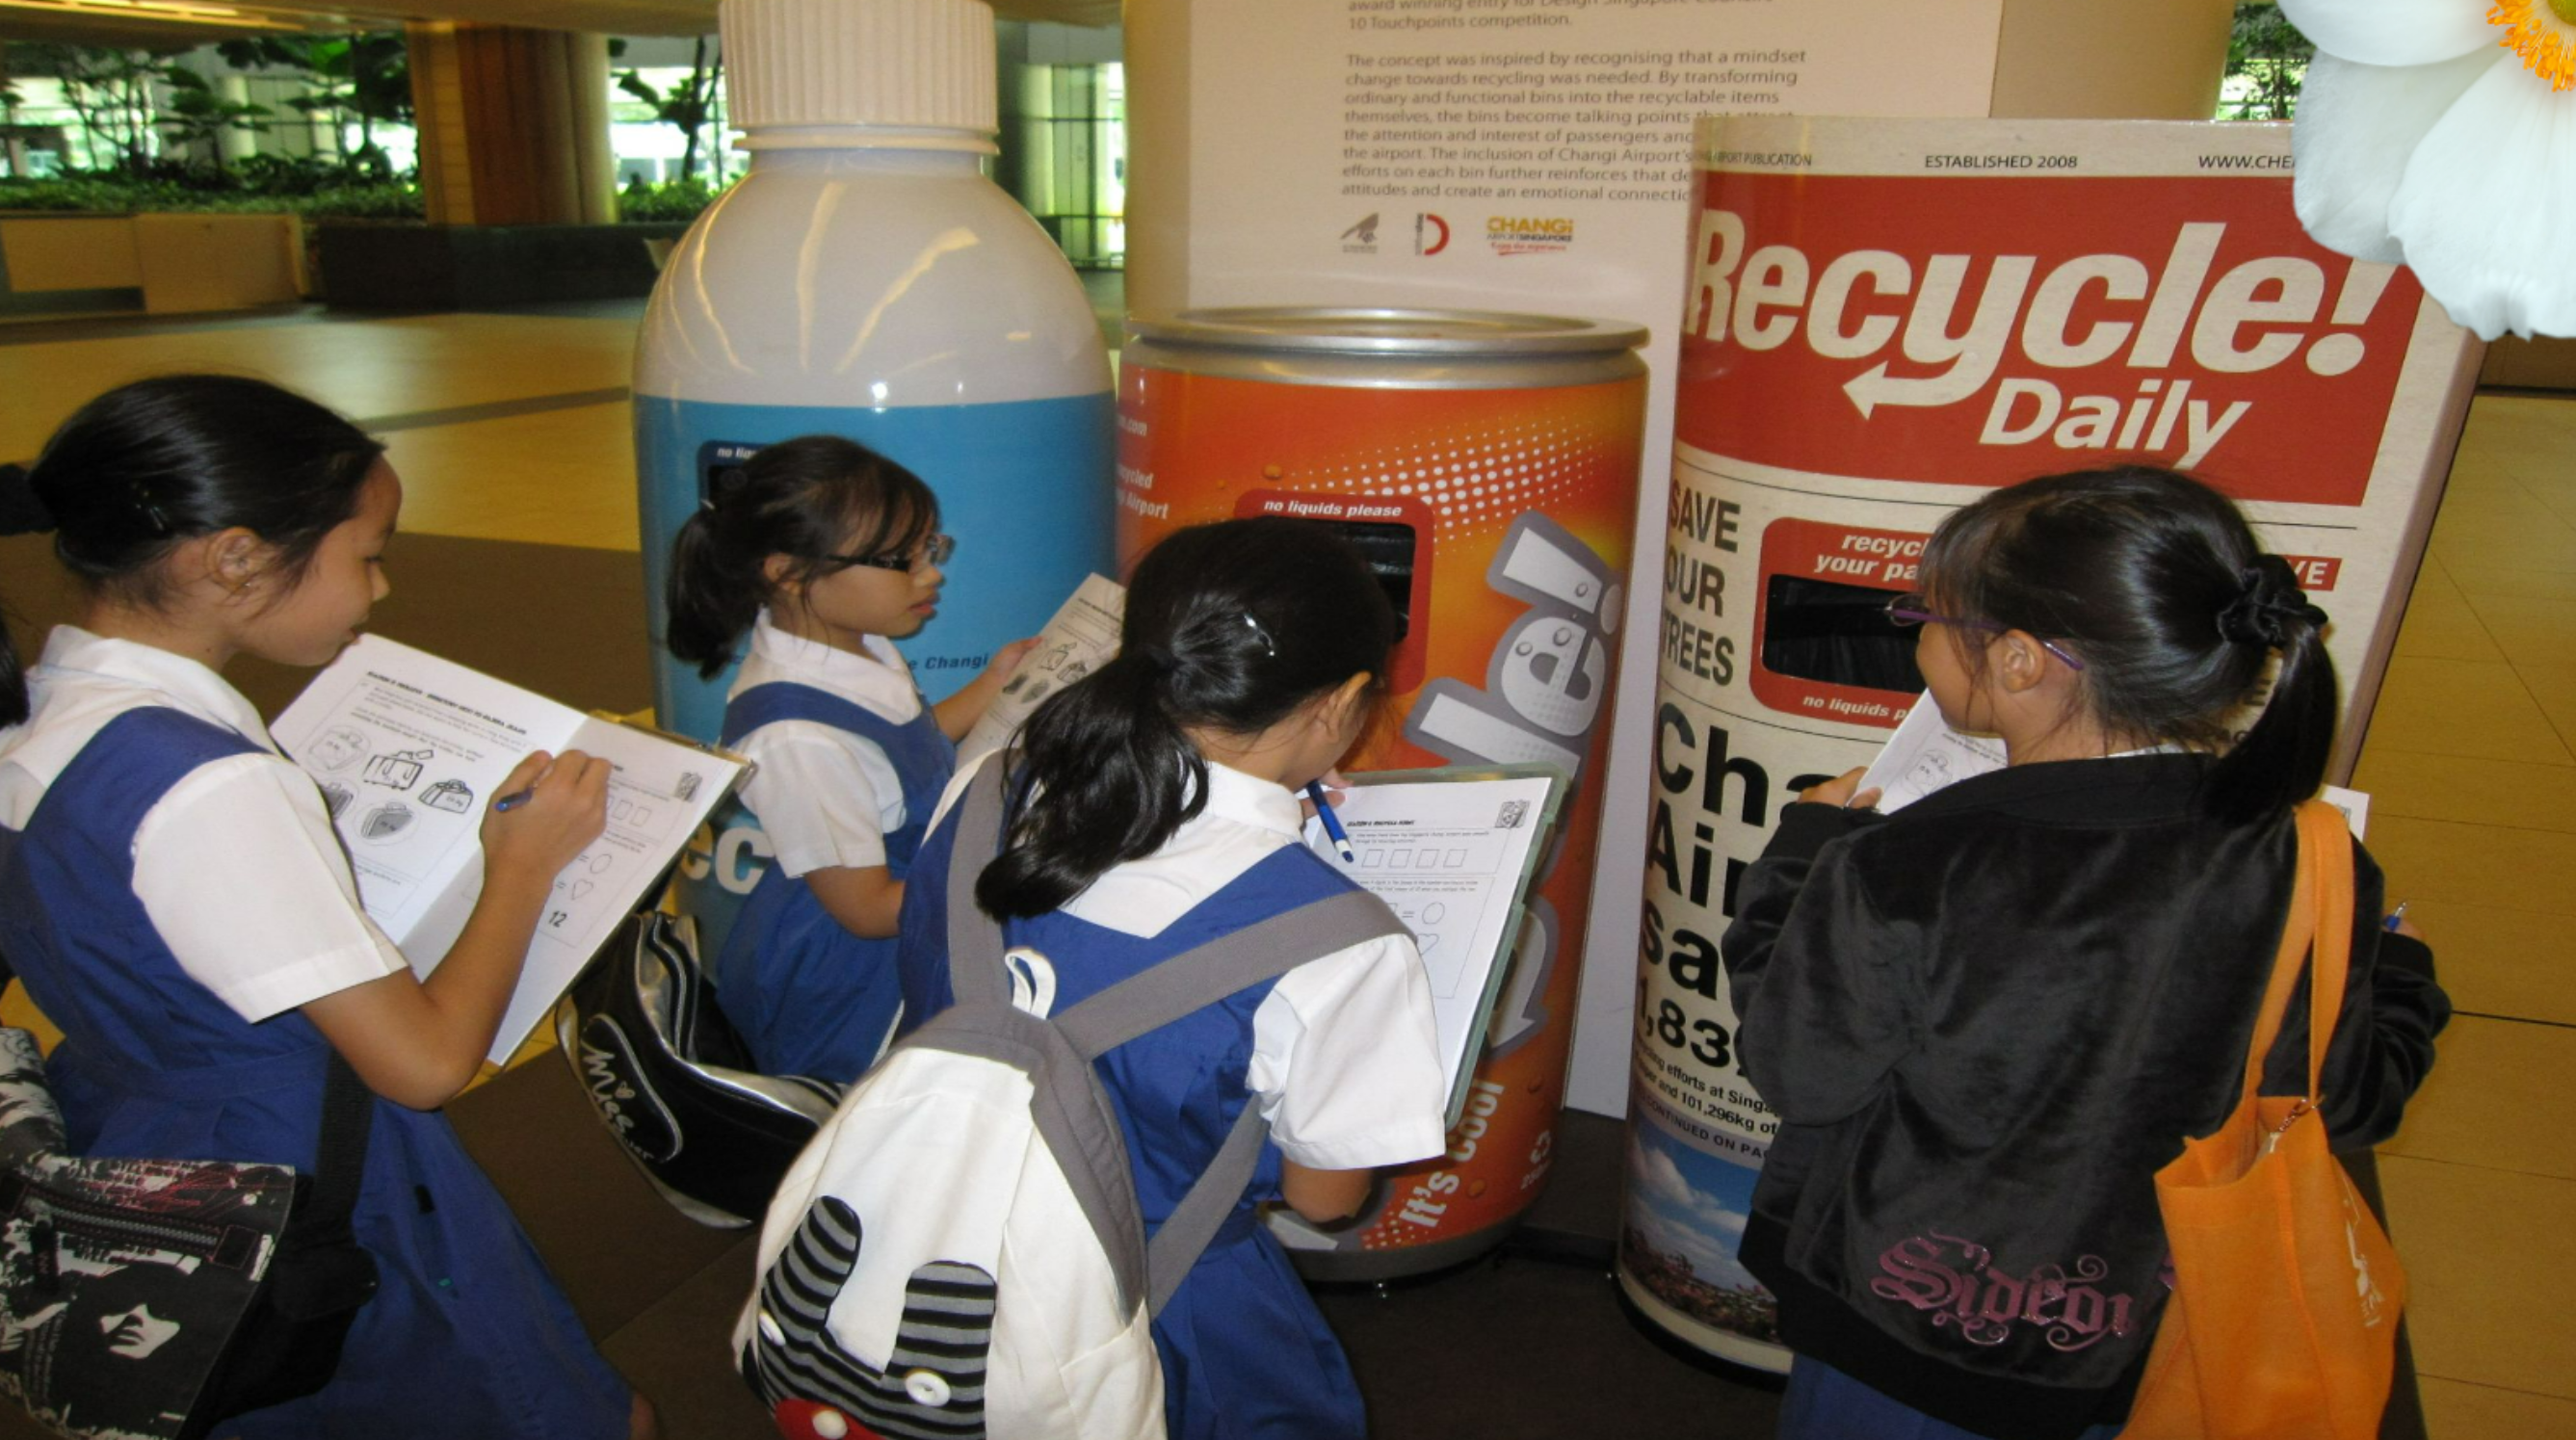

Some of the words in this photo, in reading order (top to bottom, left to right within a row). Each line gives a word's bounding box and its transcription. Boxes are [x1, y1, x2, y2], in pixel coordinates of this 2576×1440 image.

[1350, 15, 1368, 30] 10
[1371, 14, 1465, 32] Touchpoints
[1468, 13, 1574, 28] competition.
[1347, 54, 1375, 66] The
[1378, 54, 1441, 68] concept
[1445, 55, 1476, 66] was
[1480, 52, 1544, 68] inspired
[1549, 52, 1571, 67] by
[1574, 51, 1673, 68] recognising
[1677, 50, 1713, 64] that
[1717, 53, 1729, 64] a
[1733, 49, 1807, 64] mindset
[1345, 73, 1403, 88] change
[1406, 73, 1468, 85] towards
[1472, 71, 1545, 88] recycling
[1549, 74, 1581, 85] was
[1585, 70, 1654, 84] needed.
[1659, 70, 1681, 87] By
[1684, 68, 1799, 88] transforming
[1345, 92, 1406, 107] ordinary
[1413, 92, 1441, 105] and
[1445, 91, 1525, 105] functional
[1530, 91, 1564, 104] bins
[1568, 91, 1602, 104] into
[1607, 91, 1636, 103] the
[1639, 90, 1725, 106] recyclable
[1731, 90, 1780, 103] items
[1345, 110, 1433, 123] themselves,
[1437, 110, 1462, 122] the
[1467, 110, 1500, 122] bins
[1505, 110, 1571, 123] become
[1576, 108, 1632, 125] talking
[1638, 109, 1692, 124] points
[1345, 129, 1369, 142] the
[1372, 129, 1443, 142] attention
[1446, 129, 1477, 142] and
[1482, 129, 1539, 143] interest
[1543, 129, 1562, 143] of
[1564, 131, 1659, 148] passengers
[1344, 147, 1368, 160] the
[1372, 147, 1425, 162] airport.
[1432, 147, 1459, 161] The
[1463, 147, 1535, 162] inclusion
[1538, 147, 1555, 162] of
[1558, 147, 1617, 165] Changi
[1621, 148, 1693, 166] Airport's
[1745, 152, 1812, 167] PUBLICATION
[1925, 155, 2034, 169] ESTABLISHED
[2037, 155, 2079, 169] 2008
[1343, 166, 1390, 178] efforts
[1393, 169, 1414, 178] on
[1417, 166, 1455, 179] each
[1459, 166, 1485, 179] bin
[1489, 166, 1542, 180] further
[1547, 167, 1627, 182] reinforces
[1632, 168, 1666, 182] that
[1342, 184, 1407, 196] attitudes
[1411, 184, 1441, 197] and
[1445, 185, 1493, 198] create
[1496, 188, 1517, 199] an
[1521, 186, 1604, 200] emotional
[1684, 208, 2397, 421] Recycle!
[1979, 378, 2252, 470] Daily
[717, 447, 733, 458] no
[1126, 491, 1170, 519] Airport
[1264, 500, 1284, 511] no
[1288, 500, 1343, 515] liquids
[1346, 504, 1403, 517] please
[1669, 478, 1741, 554] SAVE
[1814, 554, 1879, 576] your
[1665, 543, 1725, 618] OUR
[1663, 607, 1735, 687] TREES
[925, 652, 989, 671] Changi
[1802, 695, 1825, 709] no
[1828, 698, 1890, 717] liquids
[548, 910, 568, 928] 12
[1668, 1063, 1708, 1094] efforts
[1710, 1085, 1724, 1101] at
[1659, 1079, 1679, 1100] and
[1681, 1092, 1756, 1133] 101,296kg
[1648, 1097, 1710, 1141] CONTINUED
[1714, 1135, 1737, 1152] ON
[1399, 1170, 1460, 1228] It's
